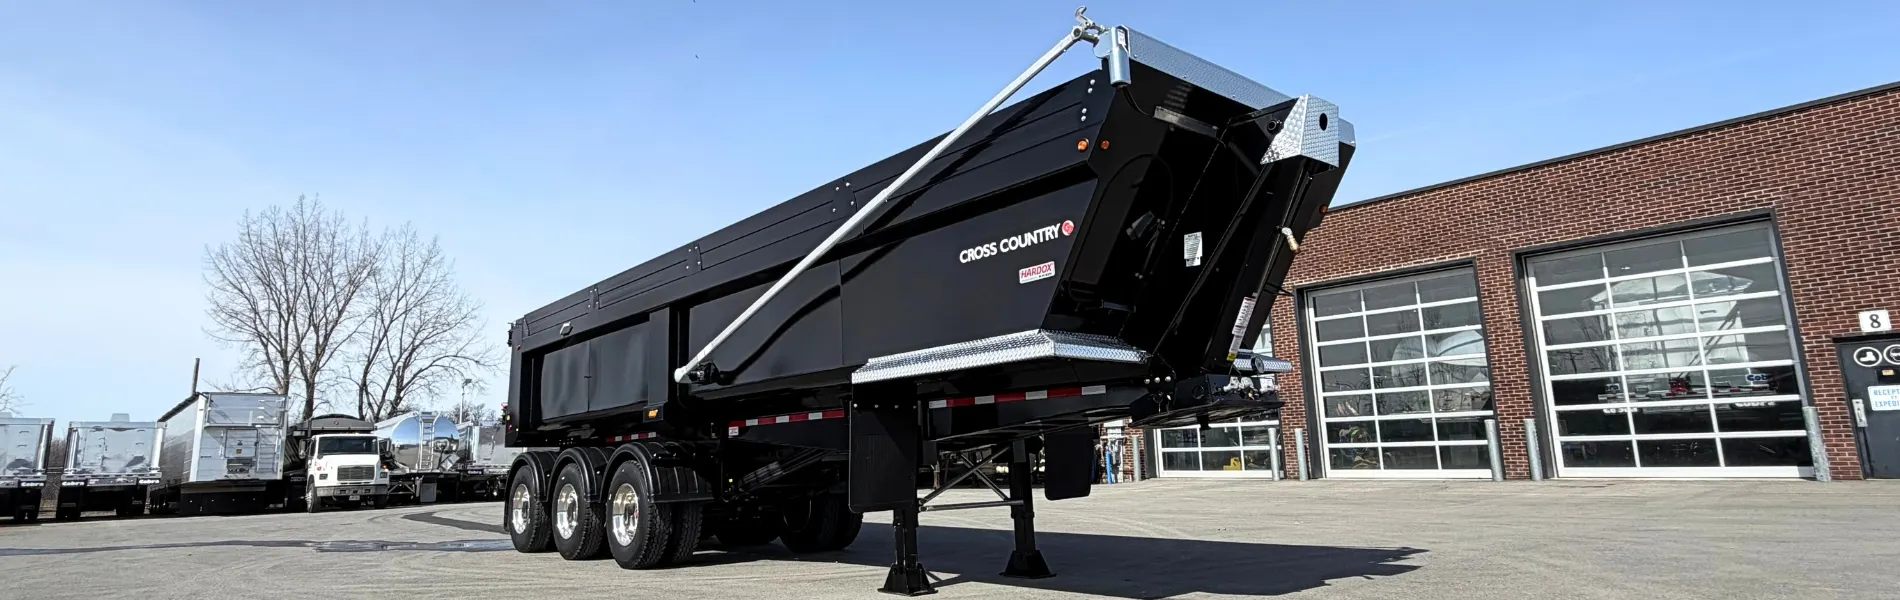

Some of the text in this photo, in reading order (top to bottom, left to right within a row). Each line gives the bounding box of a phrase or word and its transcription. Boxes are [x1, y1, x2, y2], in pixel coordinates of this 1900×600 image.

[959, 223, 1061, 264] CROSS COUNTRY
[1020, 263, 1053, 279] HARDOX
[1869, 313, 1882, 329] 8
